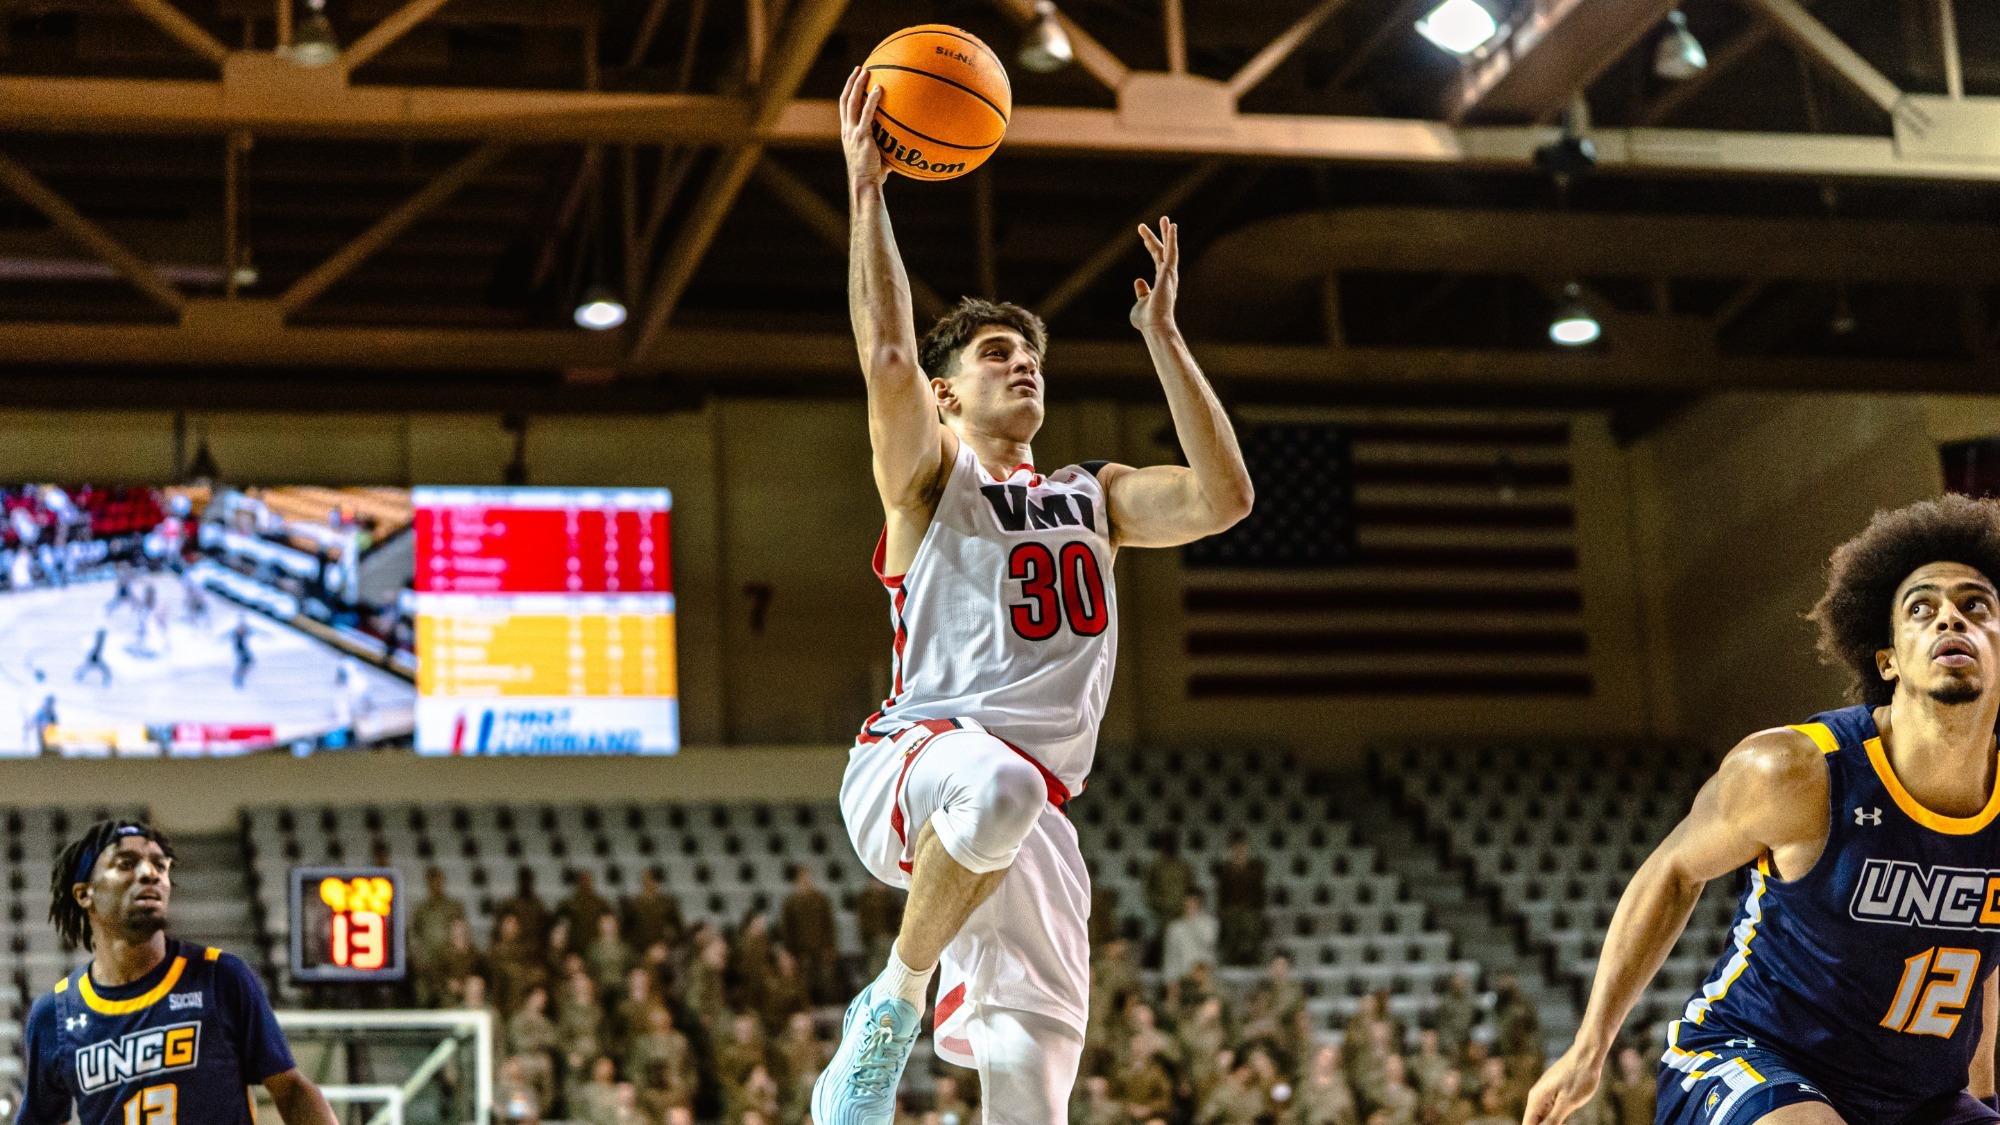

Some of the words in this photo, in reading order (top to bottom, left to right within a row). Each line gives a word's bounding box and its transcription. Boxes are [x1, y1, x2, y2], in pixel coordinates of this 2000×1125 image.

[872, 119, 967, 174] Wilson
[980, 484, 1096, 532] VMI
[742, 582, 775, 635] 7
[1008, 540, 1108, 641] 30
[332, 911, 387, 970] 13
[1879, 946, 1981, 1039] 12
[77, 1022, 200, 1092] UNCG
